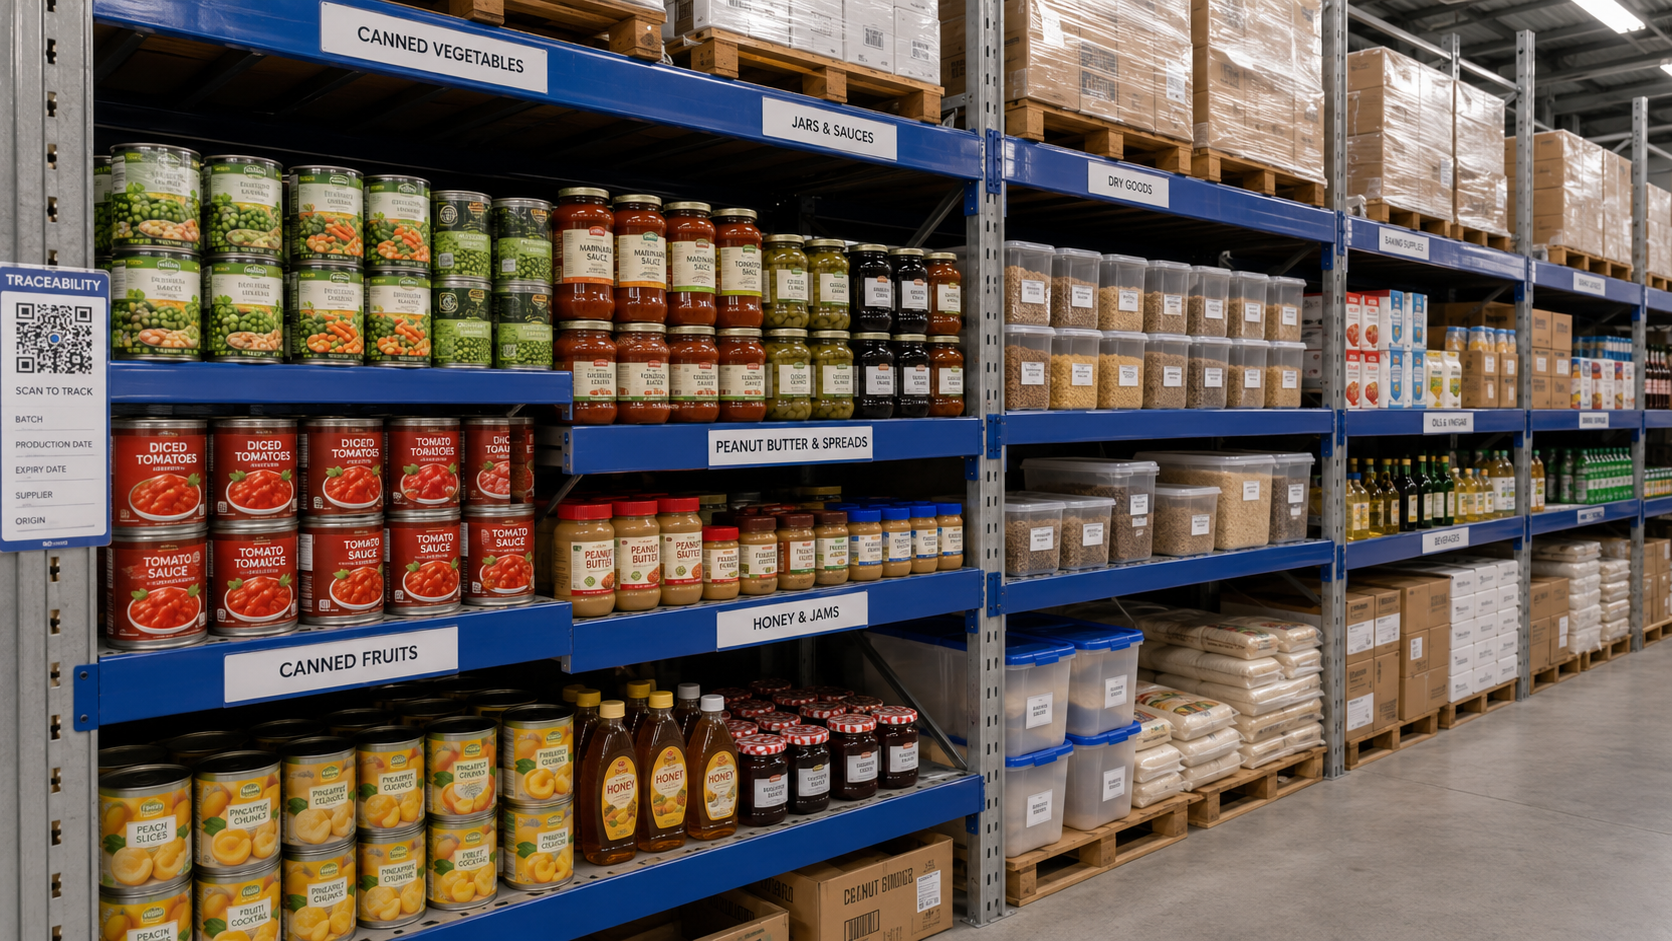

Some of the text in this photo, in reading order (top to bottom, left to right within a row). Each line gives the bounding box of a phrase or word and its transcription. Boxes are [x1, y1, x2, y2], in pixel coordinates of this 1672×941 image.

[357, 26, 524, 73] CANNED VEGETABLES
[792, 116, 874, 144] JARS & SAUCES
[1108, 175, 1153, 195] DRY GOODS
[6, 274, 101, 291] TRACEABILITY
[15, 386, 93, 396] SCAN TO TRACK
[15, 415, 43, 423] BATCH
[15, 440, 93, 448] PRODUCTION DATE
[150, 442, 187, 453] DICED
[247, 440, 282, 450] DICED
[716, 436, 868, 453] PEANUT BUTTER & SPREADS
[136, 453, 197, 465] TOMATOES
[235, 451, 291, 462] TOMATOES
[15, 465, 67, 474] EXPIRY DATE
[15, 490, 53, 499] SUPPLIER
[15, 516, 46, 525] ORIGIN
[416, 533, 454, 543] TOMATO
[492, 527, 528, 538] TOMATO
[420, 542, 451, 553] SAUCE
[496, 537, 525, 547] SAUCE
[239, 545, 284, 557] TOMATO
[348, 548, 377, 560] SAUCE
[143, 553, 192, 567] TOMATO
[148, 565, 188, 578] SAUCE
[753, 606, 839, 630] HONEY & JAMS
[279, 645, 418, 678] CANNED FRUITS
[607, 780, 635, 794] HONEY
